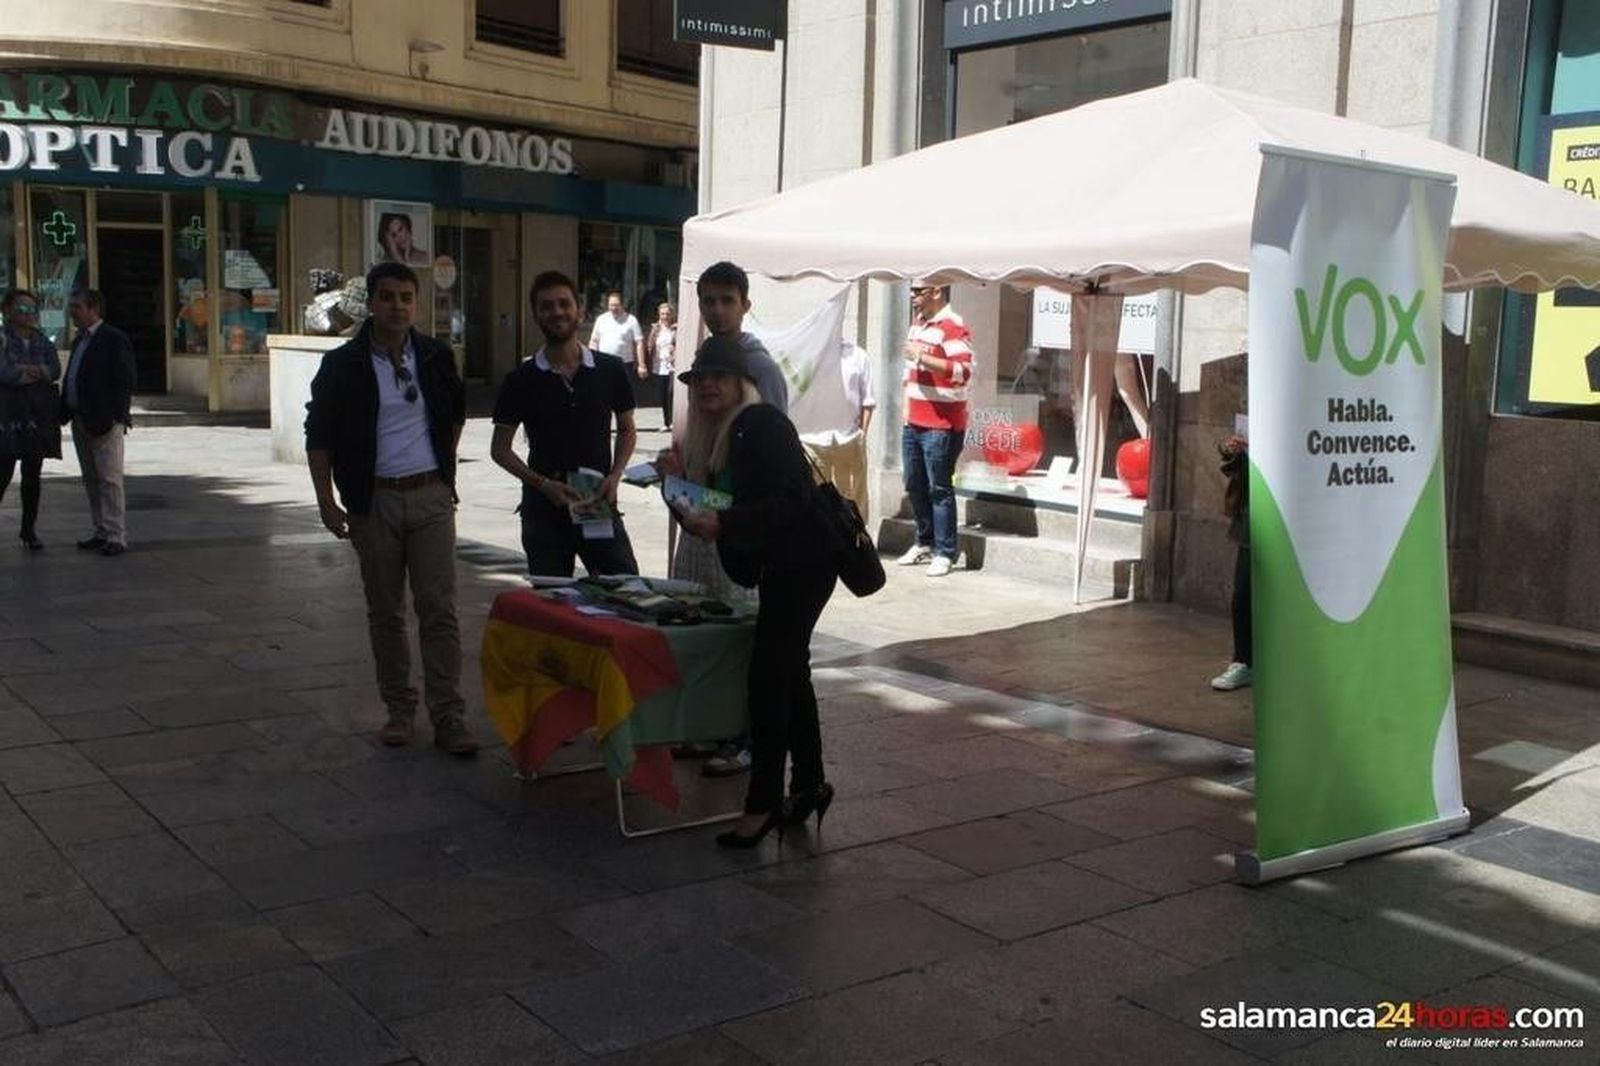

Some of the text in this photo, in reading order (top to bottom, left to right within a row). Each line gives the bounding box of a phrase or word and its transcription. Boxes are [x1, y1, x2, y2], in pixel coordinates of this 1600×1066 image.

[681, 18, 774, 39] intimissimi
[0, 122, 262, 183] OPTICA
[314, 107, 577, 175] AUDIFONOS
[1052, 301, 1069, 315] SUJ
[1123, 303, 1159, 318] FECTA
[1294, 263, 1426, 377] VOX
[1327, 398, 1393, 423] Habla.
[1307, 430, 1416, 455] Convence.
[1327, 458, 1394, 487] Actúa.
